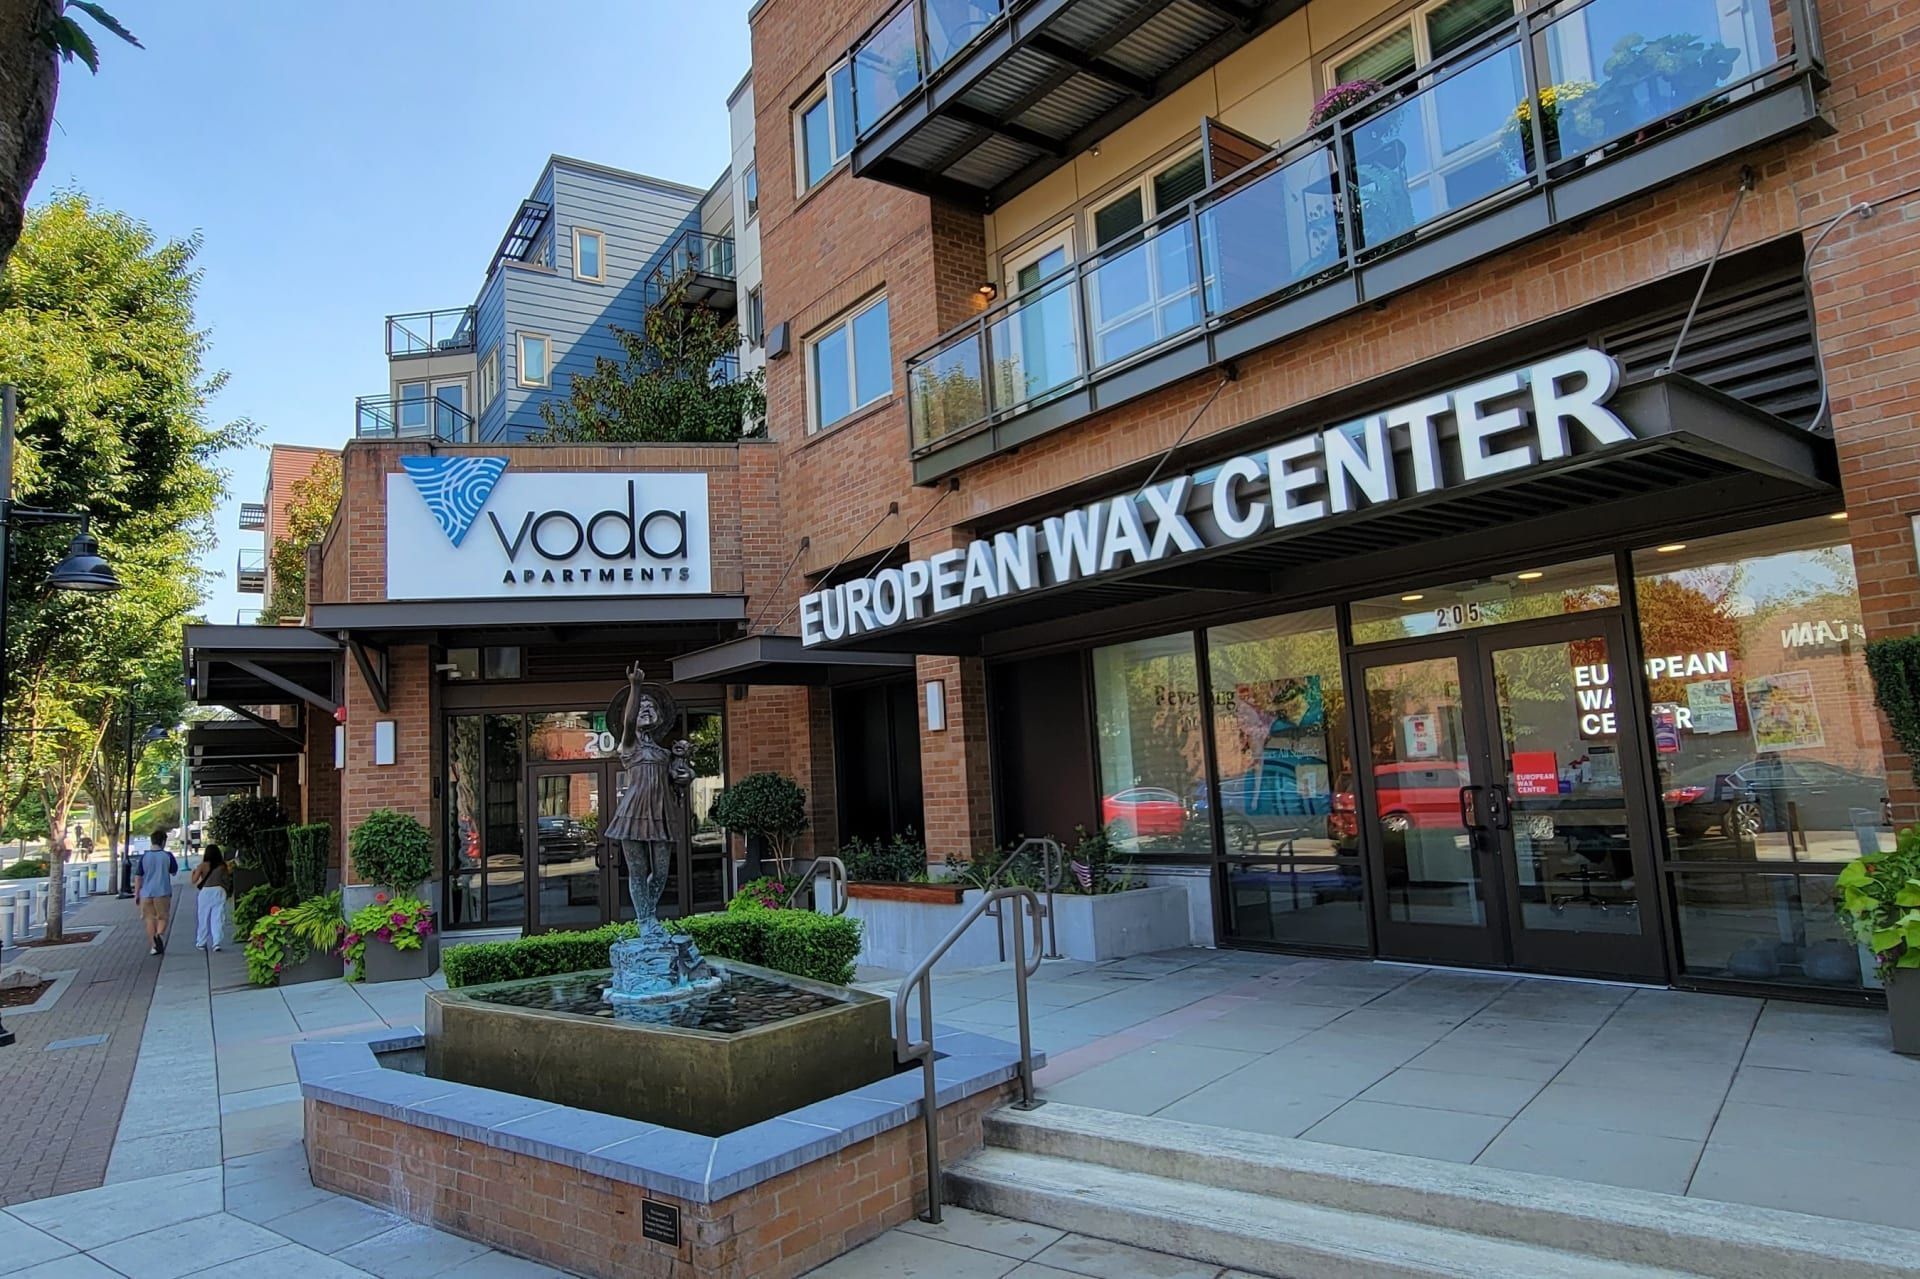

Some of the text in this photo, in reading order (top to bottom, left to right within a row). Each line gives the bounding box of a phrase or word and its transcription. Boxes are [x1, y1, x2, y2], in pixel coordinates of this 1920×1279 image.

[799, 347, 1637, 649] EUROPEAN WAX CENTER
[502, 566, 691, 584] APARTMENTS
[1436, 602, 1479, 628] 205
[1573, 650, 1729, 688] EUPEAN
[584, 732, 622, 753] 20
